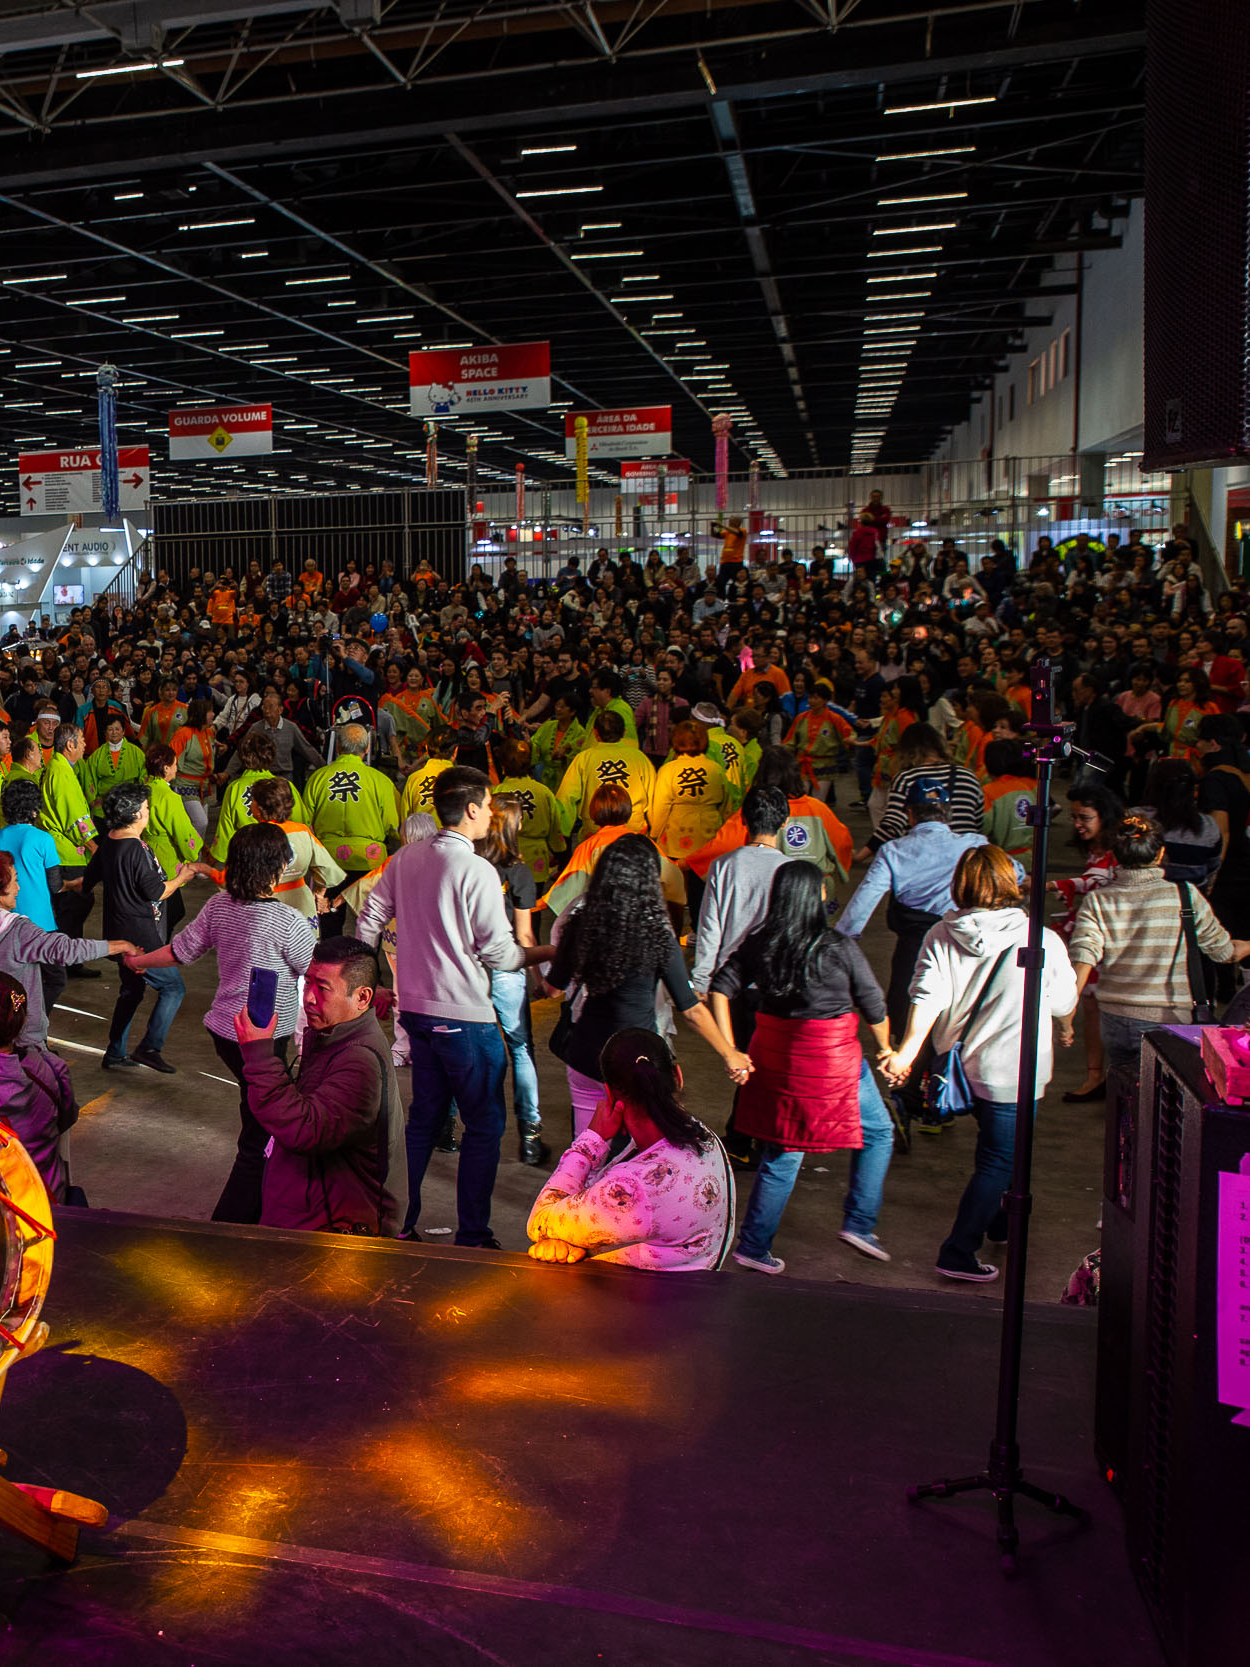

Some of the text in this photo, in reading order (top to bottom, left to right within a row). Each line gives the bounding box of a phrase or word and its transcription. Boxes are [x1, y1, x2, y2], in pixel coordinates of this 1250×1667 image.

[460, 353, 499, 366] AKIBA
[461, 367, 498, 379] SPACE
[466, 386, 528, 397] HELLO KITTY
[174, 411, 267, 426] GUARDA VOLUME
[626, 422, 656, 431] IDADE
[60, 455, 92, 468] RUA
[82, 541, 110, 552] AUDIO
[597, 759, 630, 789] 祭
[328, 770, 362, 803] 祭
[677, 766, 709, 798] 祭
[787, 826, 807, 844] 光
